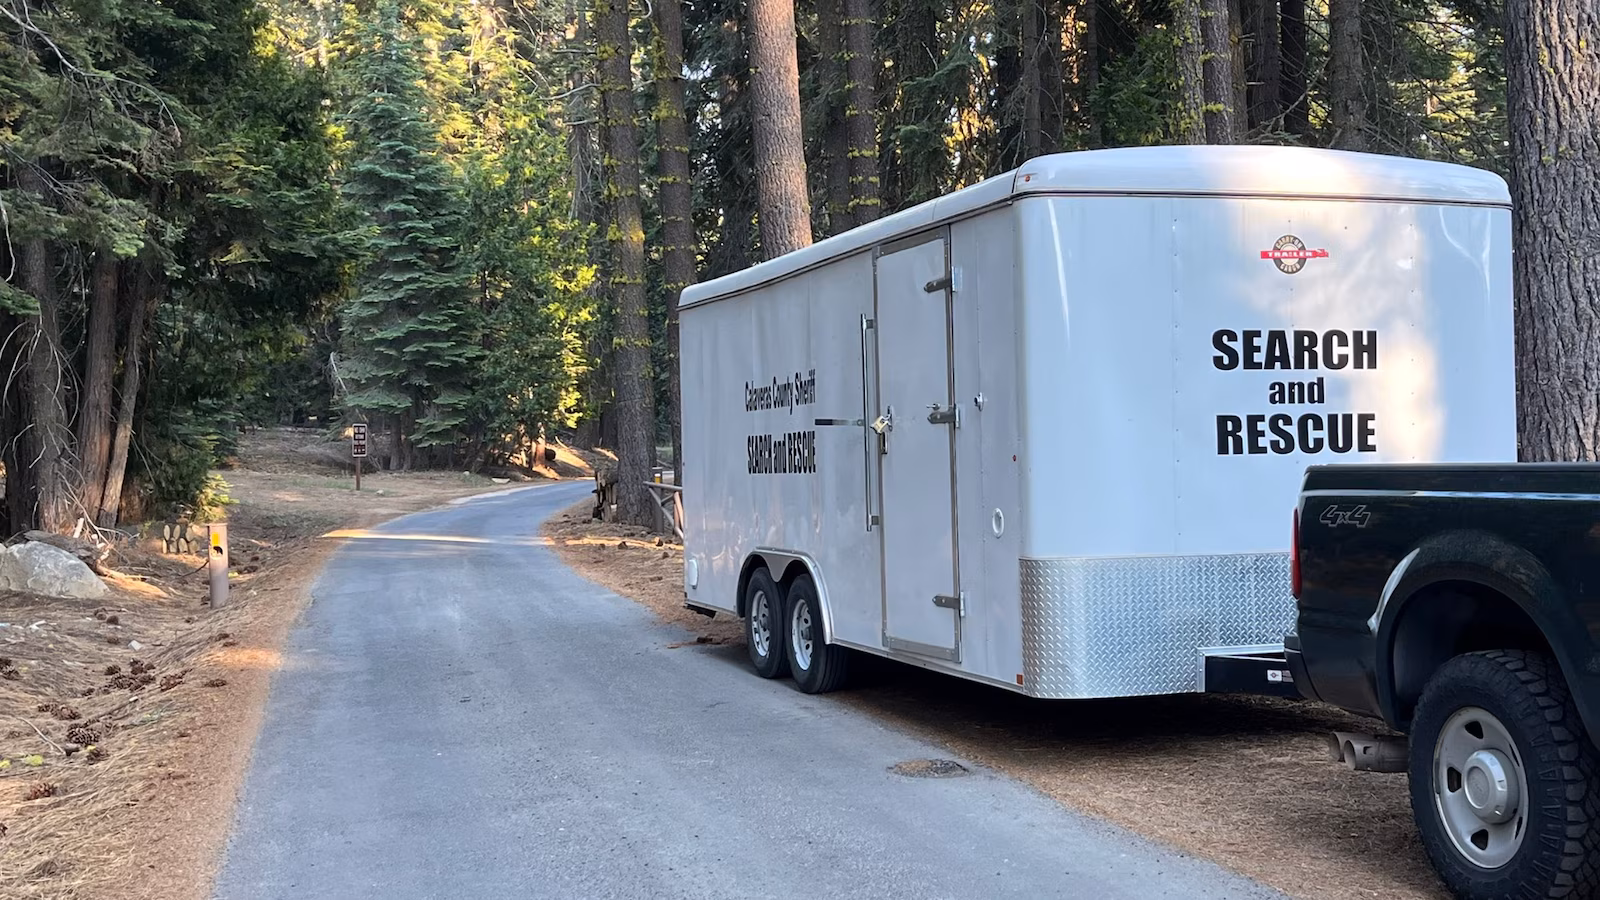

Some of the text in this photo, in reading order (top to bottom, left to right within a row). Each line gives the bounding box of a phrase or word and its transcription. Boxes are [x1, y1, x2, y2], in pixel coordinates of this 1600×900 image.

[1212, 329, 1377, 370] SEARCH
[745, 369, 816, 415] Calaveras County Sheriff
[1269, 377, 1325, 404] and
[747, 431, 816, 474] SEARCH and RESCUE
[1216, 413, 1377, 455] RESCUE
[1319, 504, 1372, 528] 4x4
